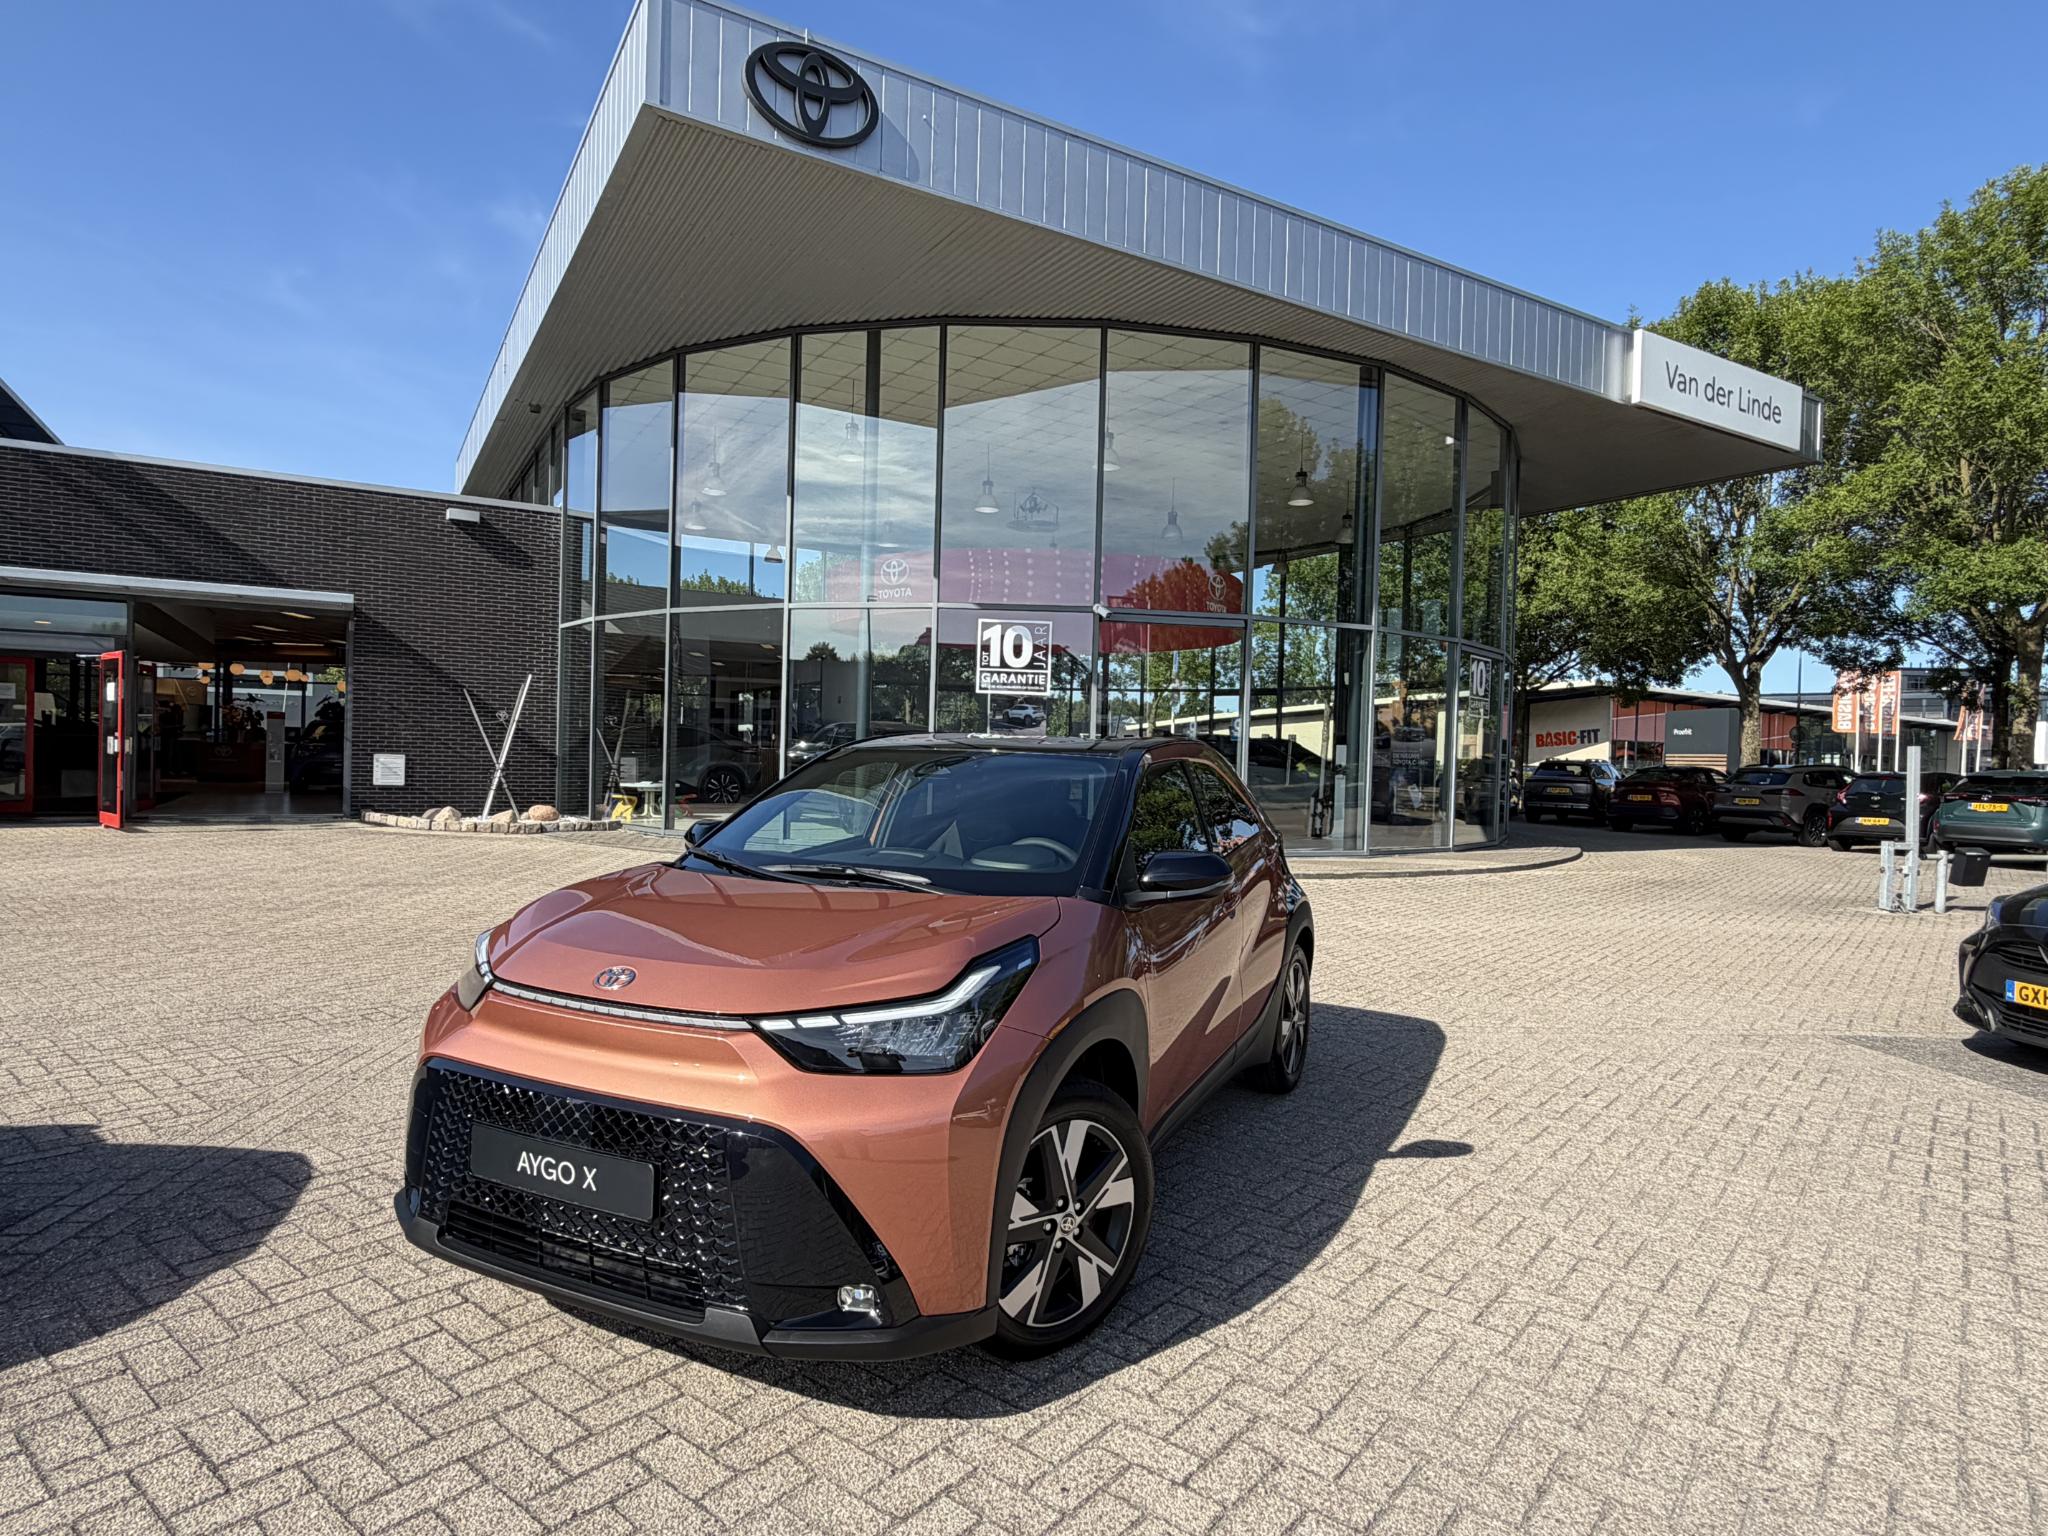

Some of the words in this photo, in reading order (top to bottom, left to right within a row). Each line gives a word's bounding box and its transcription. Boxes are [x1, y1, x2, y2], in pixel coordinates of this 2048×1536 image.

[1665, 361, 1699, 398] Van
[1704, 376, 1734, 408] der
[1738, 386, 1782, 424] Linde
[878, 587, 912, 600] TOYOTA
[981, 651, 990, 666] TOT
[982, 624, 1033, 668] 10
[1033, 626, 1047, 669] JAAR
[981, 672, 1046, 685] GARANTIE
[1471, 660, 1486, 696] 10
[1535, 729, 1600, 748] BASIC-FIT
[516, 1151, 575, 1185] AYGO
[582, 1166, 597, 1192] X
